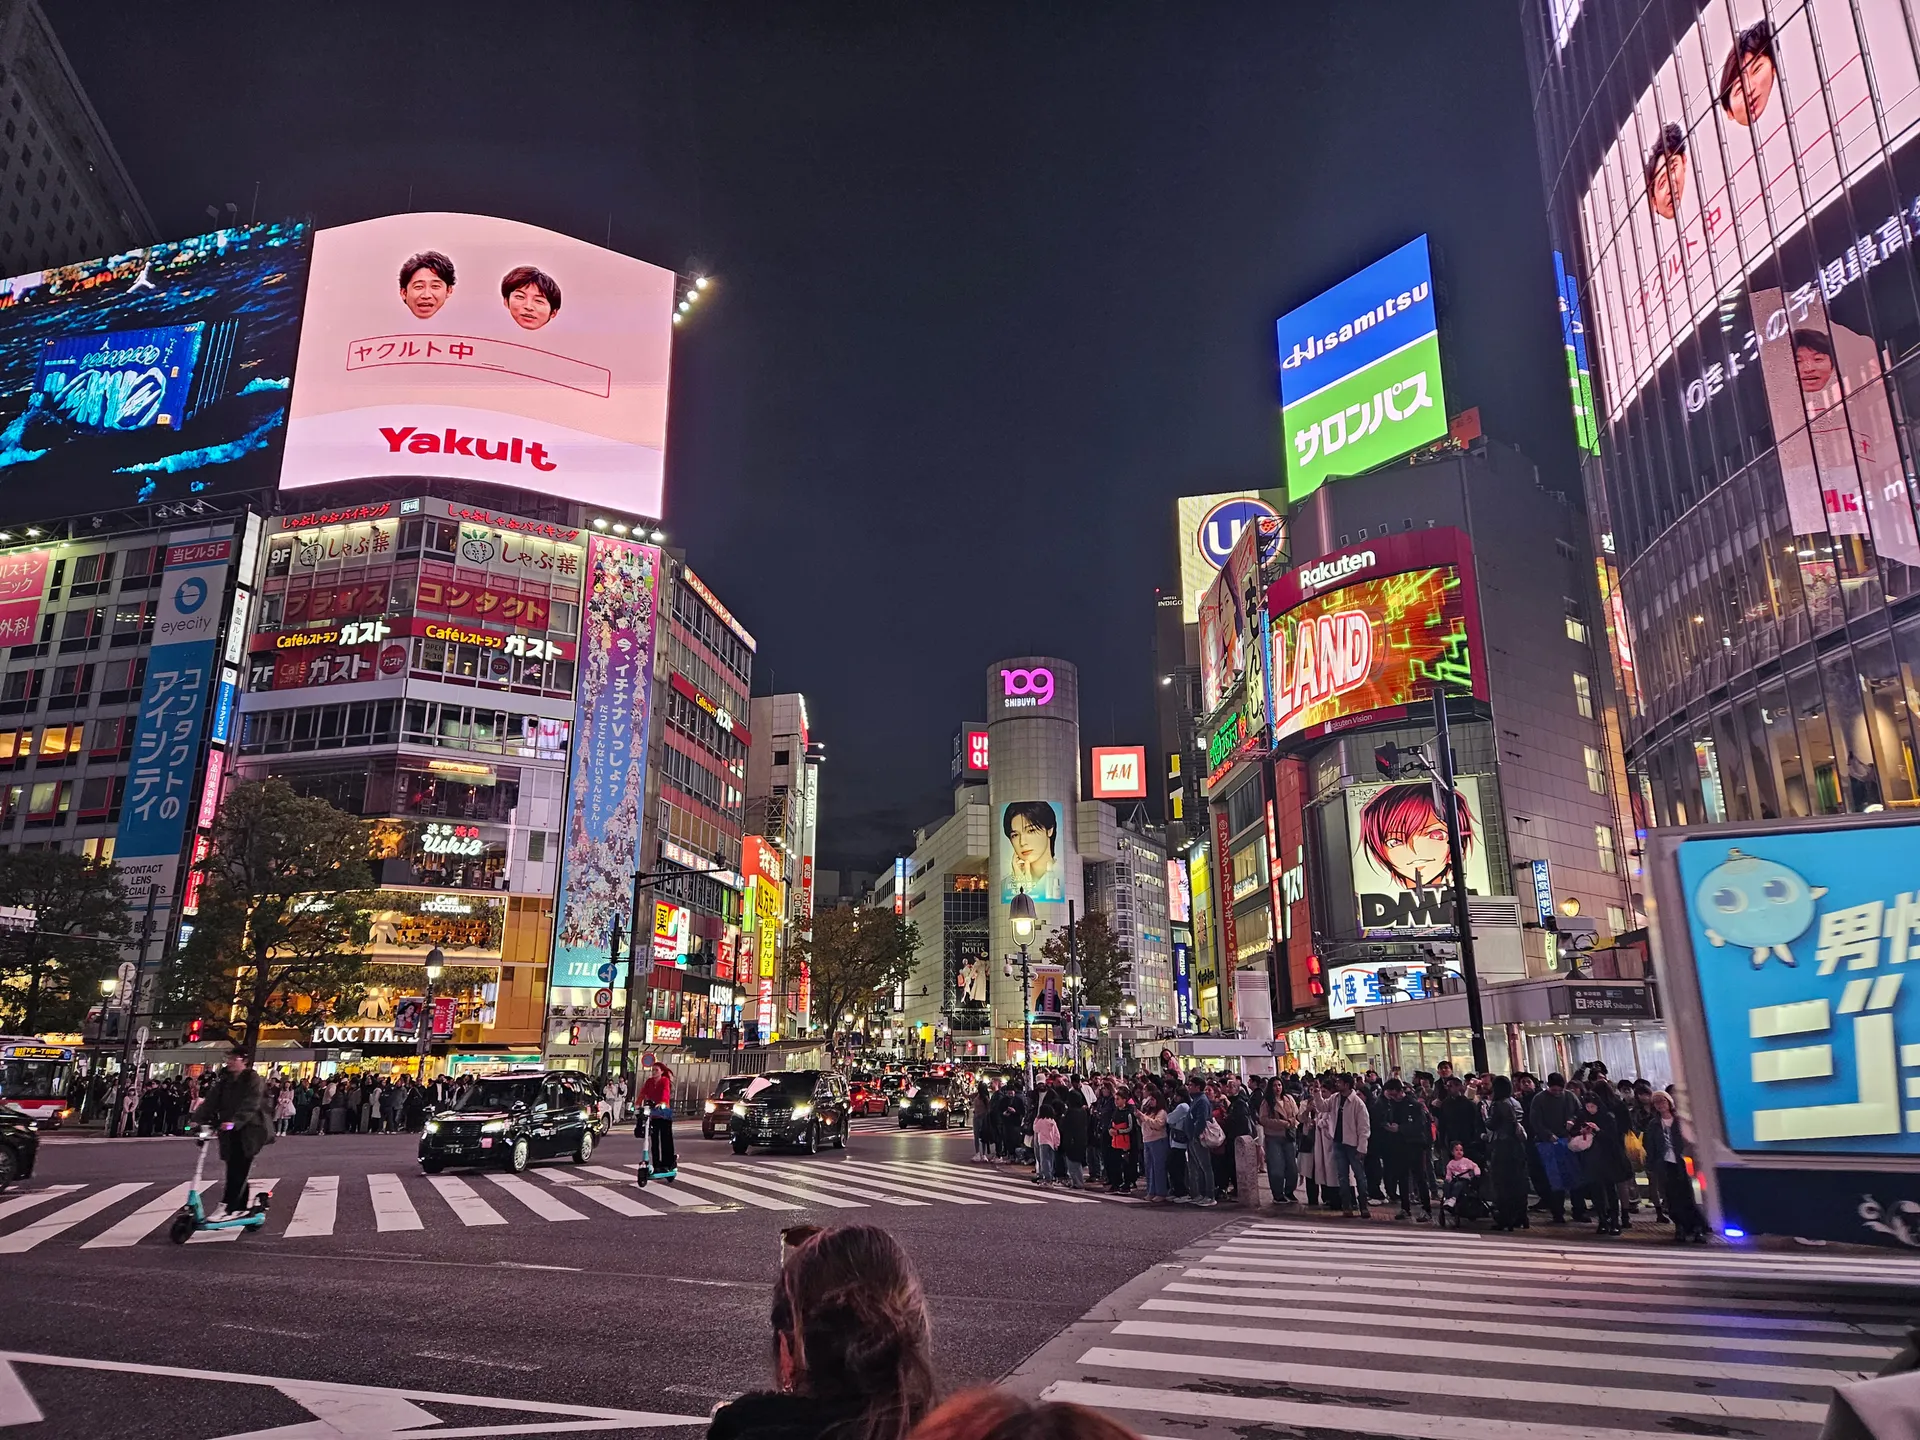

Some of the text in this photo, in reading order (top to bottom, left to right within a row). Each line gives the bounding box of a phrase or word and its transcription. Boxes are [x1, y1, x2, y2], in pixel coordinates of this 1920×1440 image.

[1282, 281, 1429, 369] Hisamitsu
[355, 341, 473, 361] ヤクルト中
[1294, 370, 1433, 467] サロンパス
[379, 426, 557, 472] Yakult
[281, 502, 391, 529] しゃぶしゃぶバイキング
[448, 503, 580, 541] しゃぶしゃぶバイキング
[172, 544, 224, 562] 当ビル5F
[271, 548, 290, 564] 9F
[328, 530, 390, 558] しゃぶ葉
[502, 541, 578, 575] しゃぶ葉
[1300, 550, 1376, 589] Rakuten
[289, 583, 384, 618] プライス
[418, 582, 546, 622] コンタクト
[161, 616, 212, 633] eyecity
[339, 621, 391, 645] ガスト
[426, 625, 562, 660] Caféレストラン ガスト
[252, 665, 275, 683] 7F
[308, 654, 371, 685] ガスト
[1274, 611, 1373, 732] LAND
[1001, 667, 1055, 706] 109
[1004, 697, 1036, 707] SHIBUYA
[1353, 714, 1373, 724] Vision
[132, 670, 180, 821] アイシティ
[159, 668, 202, 819] コンタクトの
[1106, 763, 1132, 780] H&M
[805, 788, 815, 828] CAMERA
[426, 824, 480, 838] 渋谷焼肉
[124, 864, 163, 874] CONTACT
[131, 876, 152, 884] LENS
[1220, 831, 1235, 941] ウィンターフルーツギフト
[1536, 863, 1552, 917] 大盛堂商事ビ
[962, 946, 985, 954] DOLLS
[567, 962, 600, 976] 17LI
[710, 984, 732, 1005] LUSH
[312, 1025, 419, 1043] L'OCCITA
